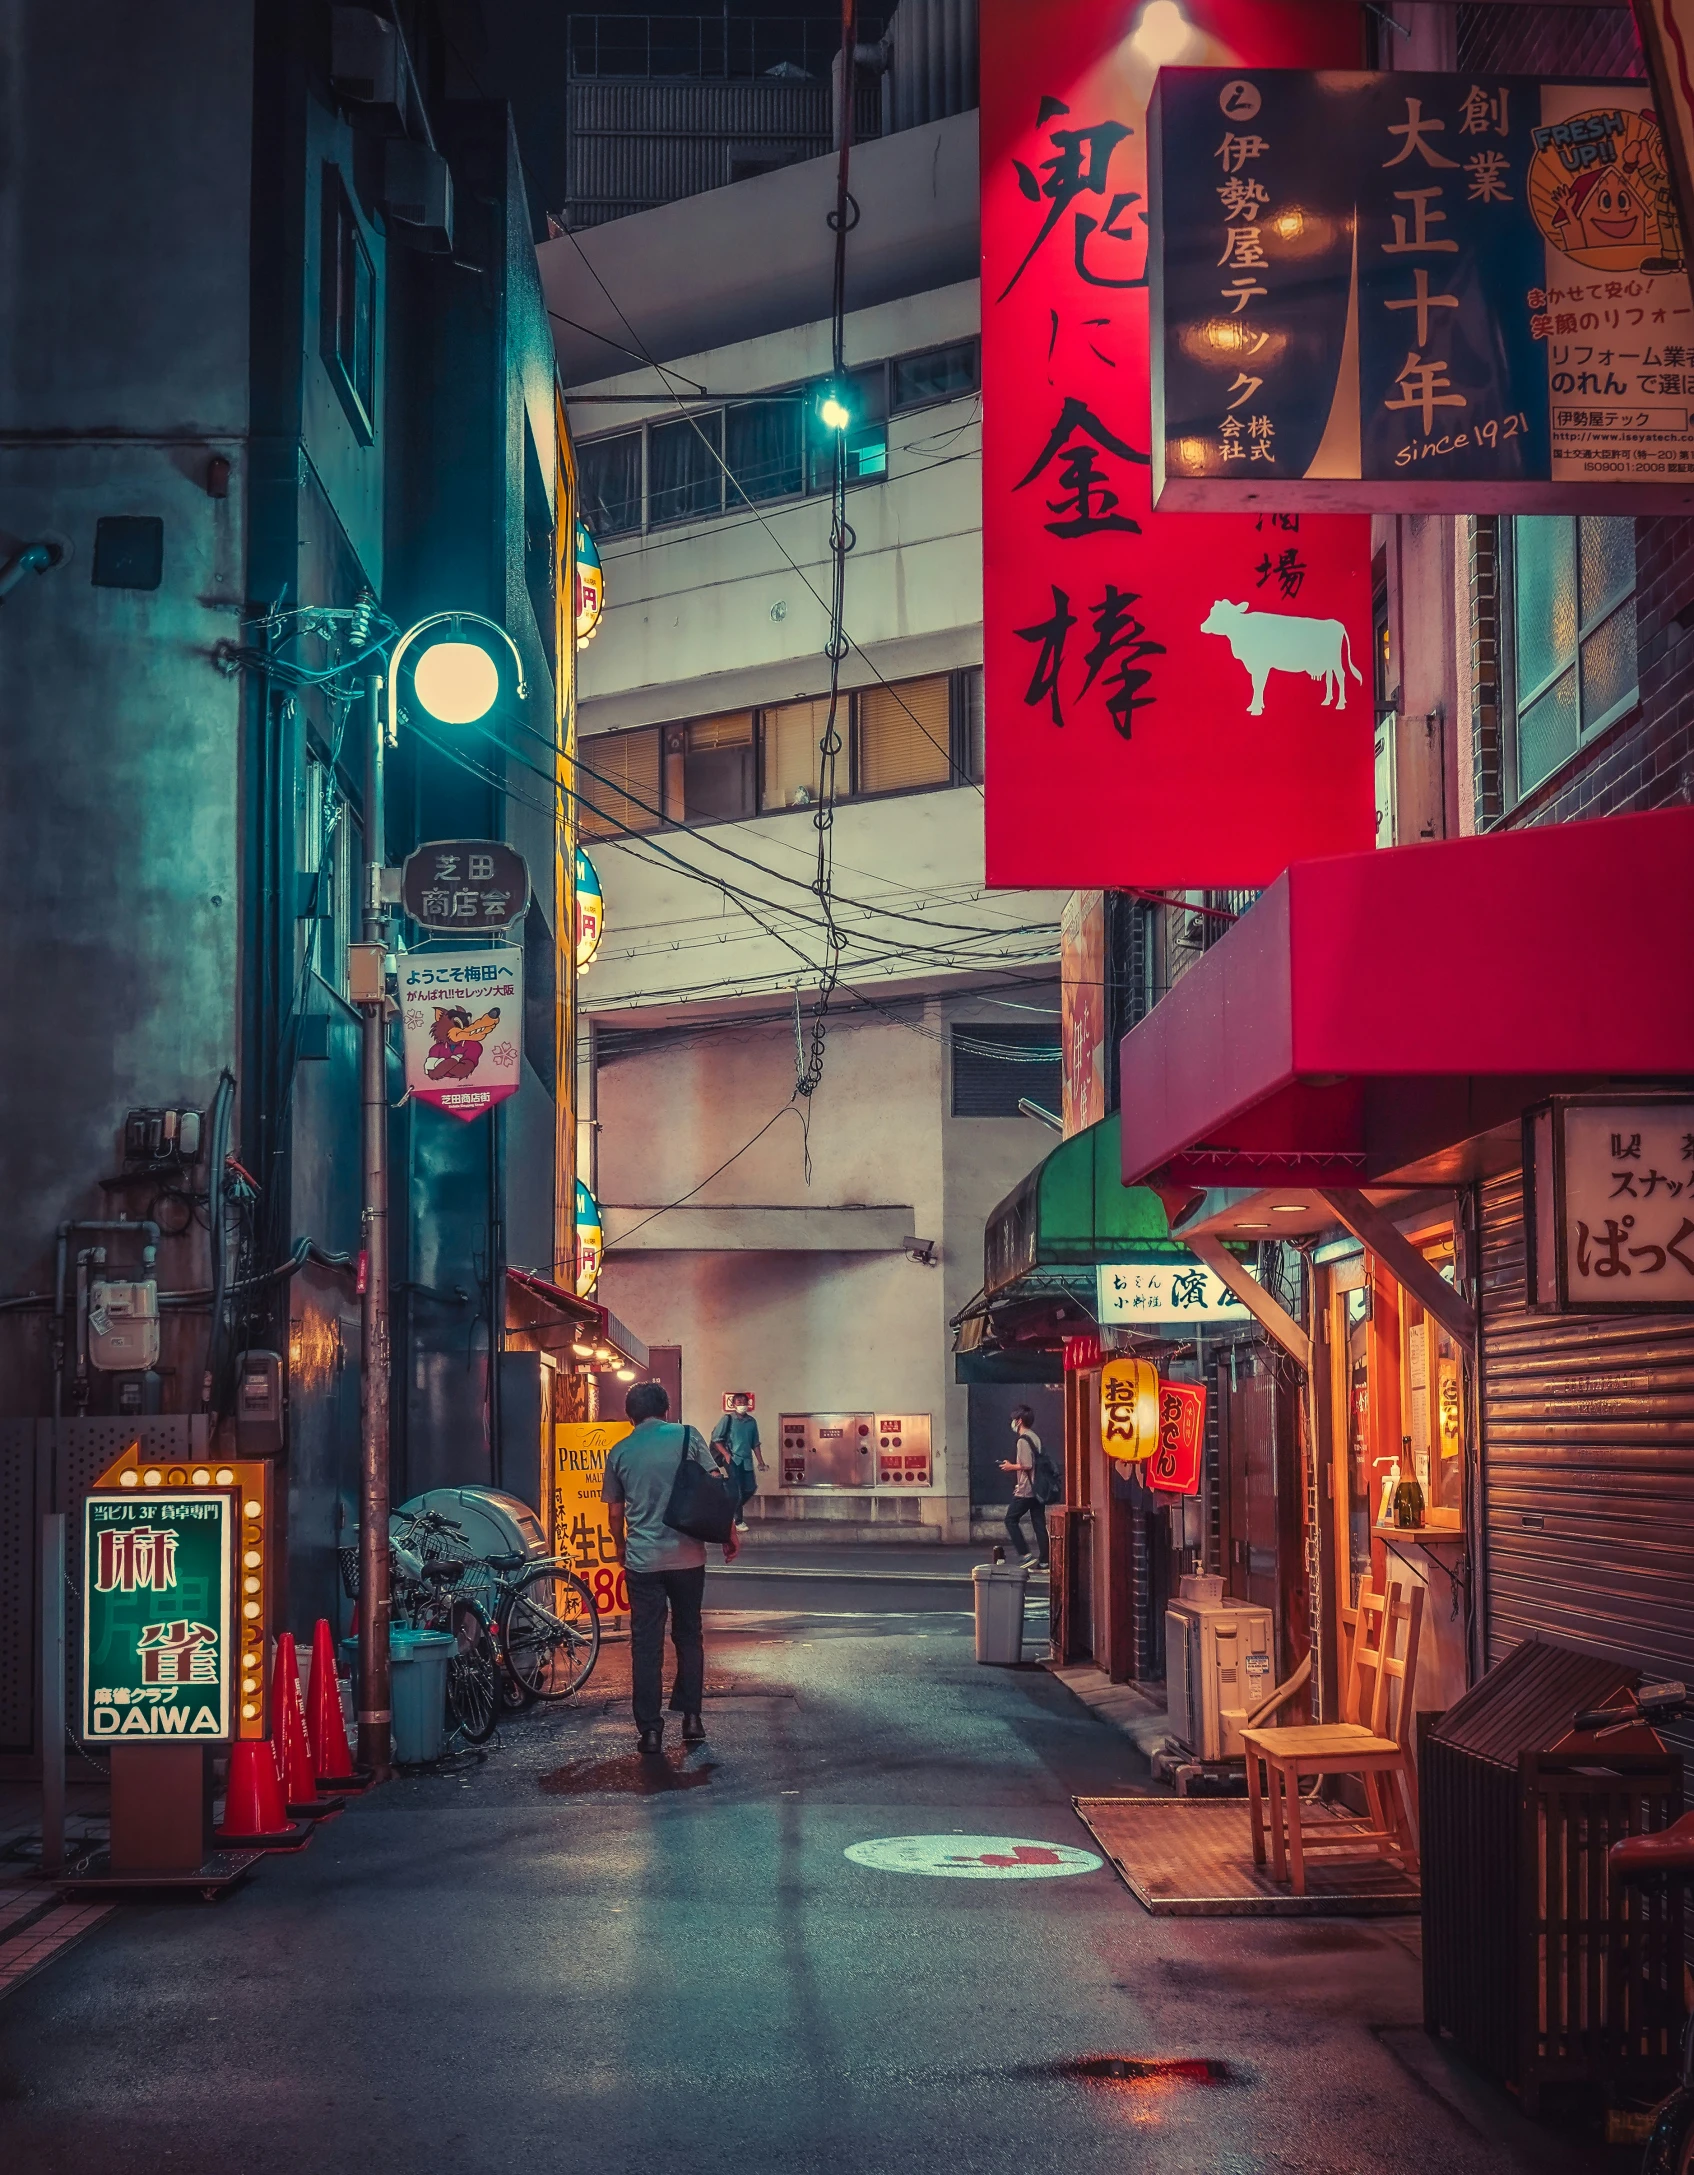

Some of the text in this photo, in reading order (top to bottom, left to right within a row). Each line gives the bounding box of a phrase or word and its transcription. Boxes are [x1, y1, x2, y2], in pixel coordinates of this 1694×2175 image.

[1458, 85, 1513, 202] 創業
[1534, 111, 1625, 153] FRESH
[1559, 138, 1618, 171] UP!!
[1214, 132, 1270, 411] 伊勢屋テック
[1382, 97, 1466, 435] 大正十年
[1529, 279, 1655, 308] まかせて安心!
[997, 96, 1167, 741] 鬼に金棒
[1558, 411, 1649, 427] 伊勢屋テック
[1394, 412, 1529, 467] since 1921
[1584, 462, 1665, 473] ISO9001:2008
[433, 854, 495, 882] 芝田
[421, 886, 511, 918] 商店会
[406, 965, 514, 985] ようこそ梅田へ
[406, 984, 515, 1002] がんばれ!!セレッソ大阪
[441, 1092, 491, 1105] 芝田商店街
[1105, 1377, 1135, 1441] おでん
[576, 1427, 612, 1447] The
[1155, 1393, 1184, 1478] おでん
[94, 1504, 219, 1521] 当ビル 3F 貸卓専門
[94, 1686, 179, 1704] 麻雀クラブ
[93, 1705, 219, 1734] DAIWA
